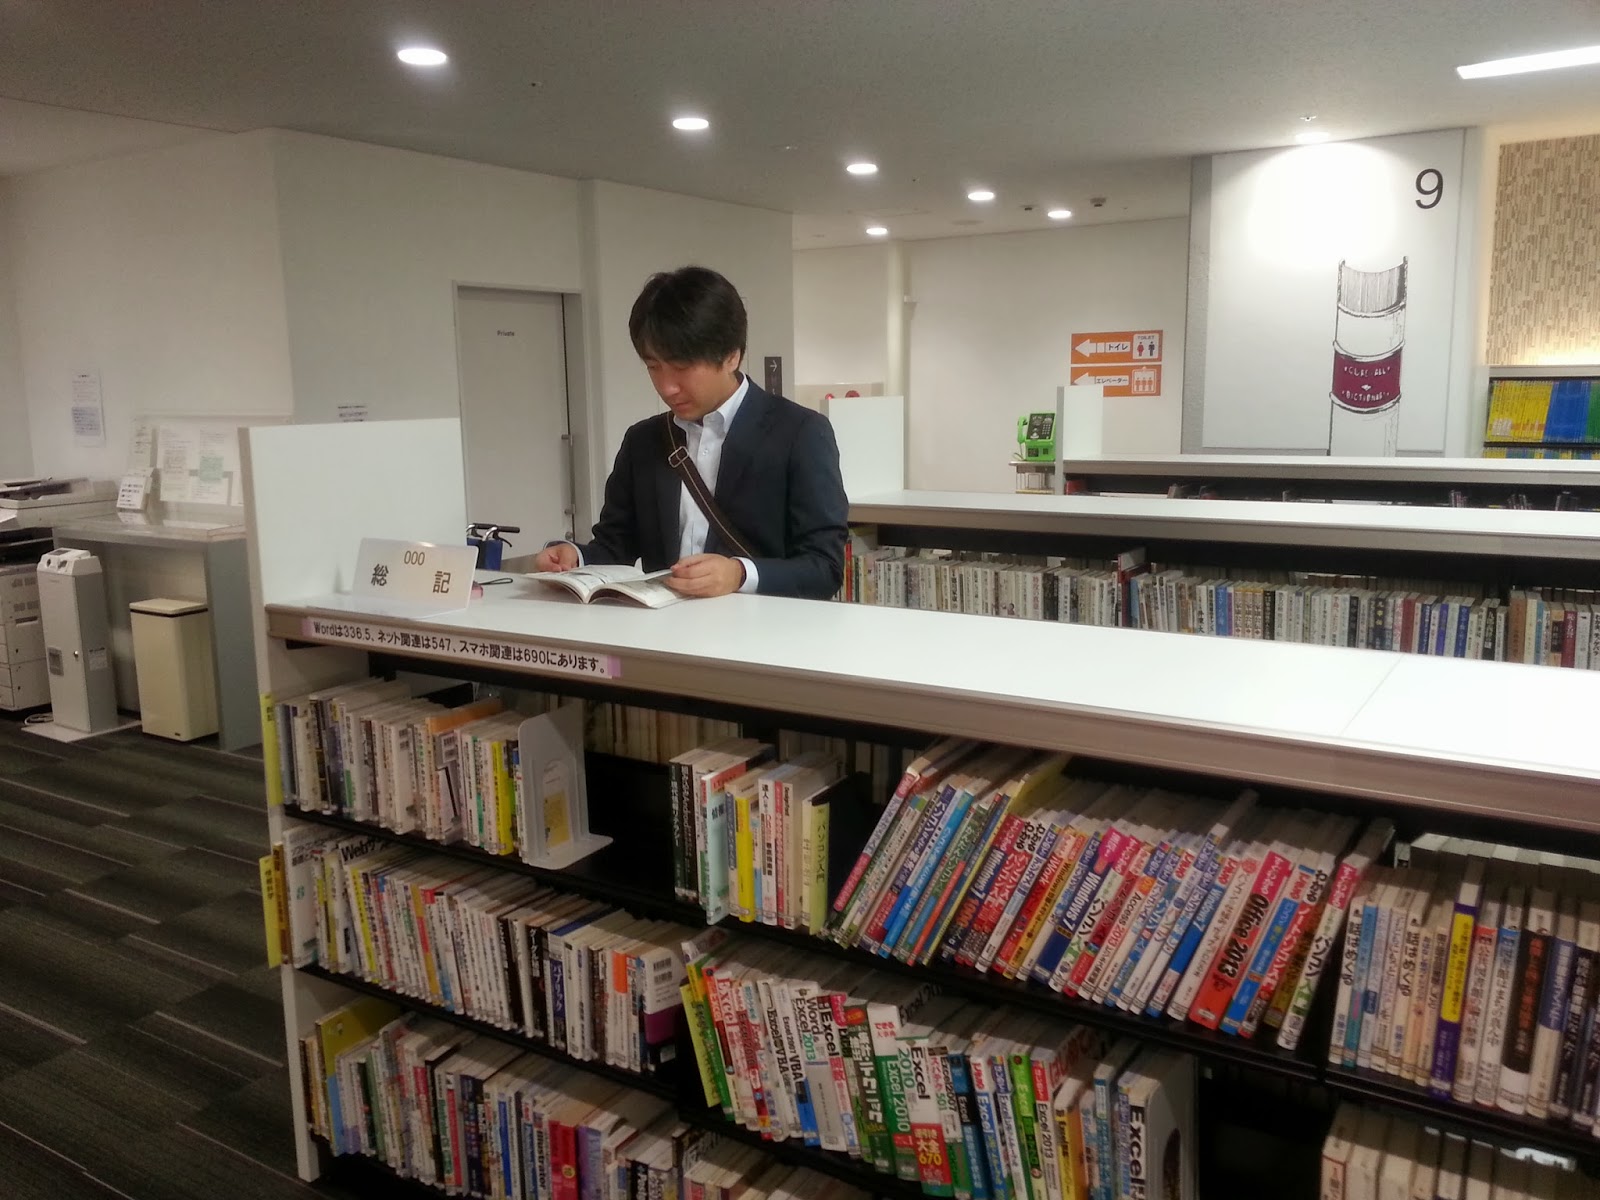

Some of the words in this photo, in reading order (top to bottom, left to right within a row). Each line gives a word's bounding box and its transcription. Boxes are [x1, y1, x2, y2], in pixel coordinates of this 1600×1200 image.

[1415, 168, 1444, 210] 9
[1108, 343, 1128, 351] トイレ
[404, 550, 426, 566] 000
[1037, 855, 1060, 887] iWork
[1063, 870, 1101, 925] Windows
[1118, 892, 1142, 927] Access
[1232, 890, 1270, 942] Office
[1060, 918, 1075, 931] 7
[1216, 936, 1249, 979] 2013
[552, 963, 564, 1014] パブリック
[717, 977, 738, 1032] Excel
[793, 998, 810, 1035] Excel
[807, 998, 824, 1036] Word
[820, 1002, 841, 1058] Excel
[801, 1034, 817, 1062] 2013
[790, 1055, 803, 1081] VBA
[898, 1048, 917, 1090] 2010
[910, 1047, 931, 1100] Excel
[886, 1060, 904, 1096] Excel
[895, 1096, 912, 1133] 2010
[958, 1096, 971, 1123] Excel
[977, 1096, 994, 1134] Excel
[1037, 1103, 1050, 1131] Excel
[536, 1130, 546, 1191] Illustrator
[916, 1139, 941, 1154] 大全
[918, 1153, 944, 1167] 670
[1042, 1132, 1053, 1158] 2013
[1129, 1105, 1147, 1187] Excel
